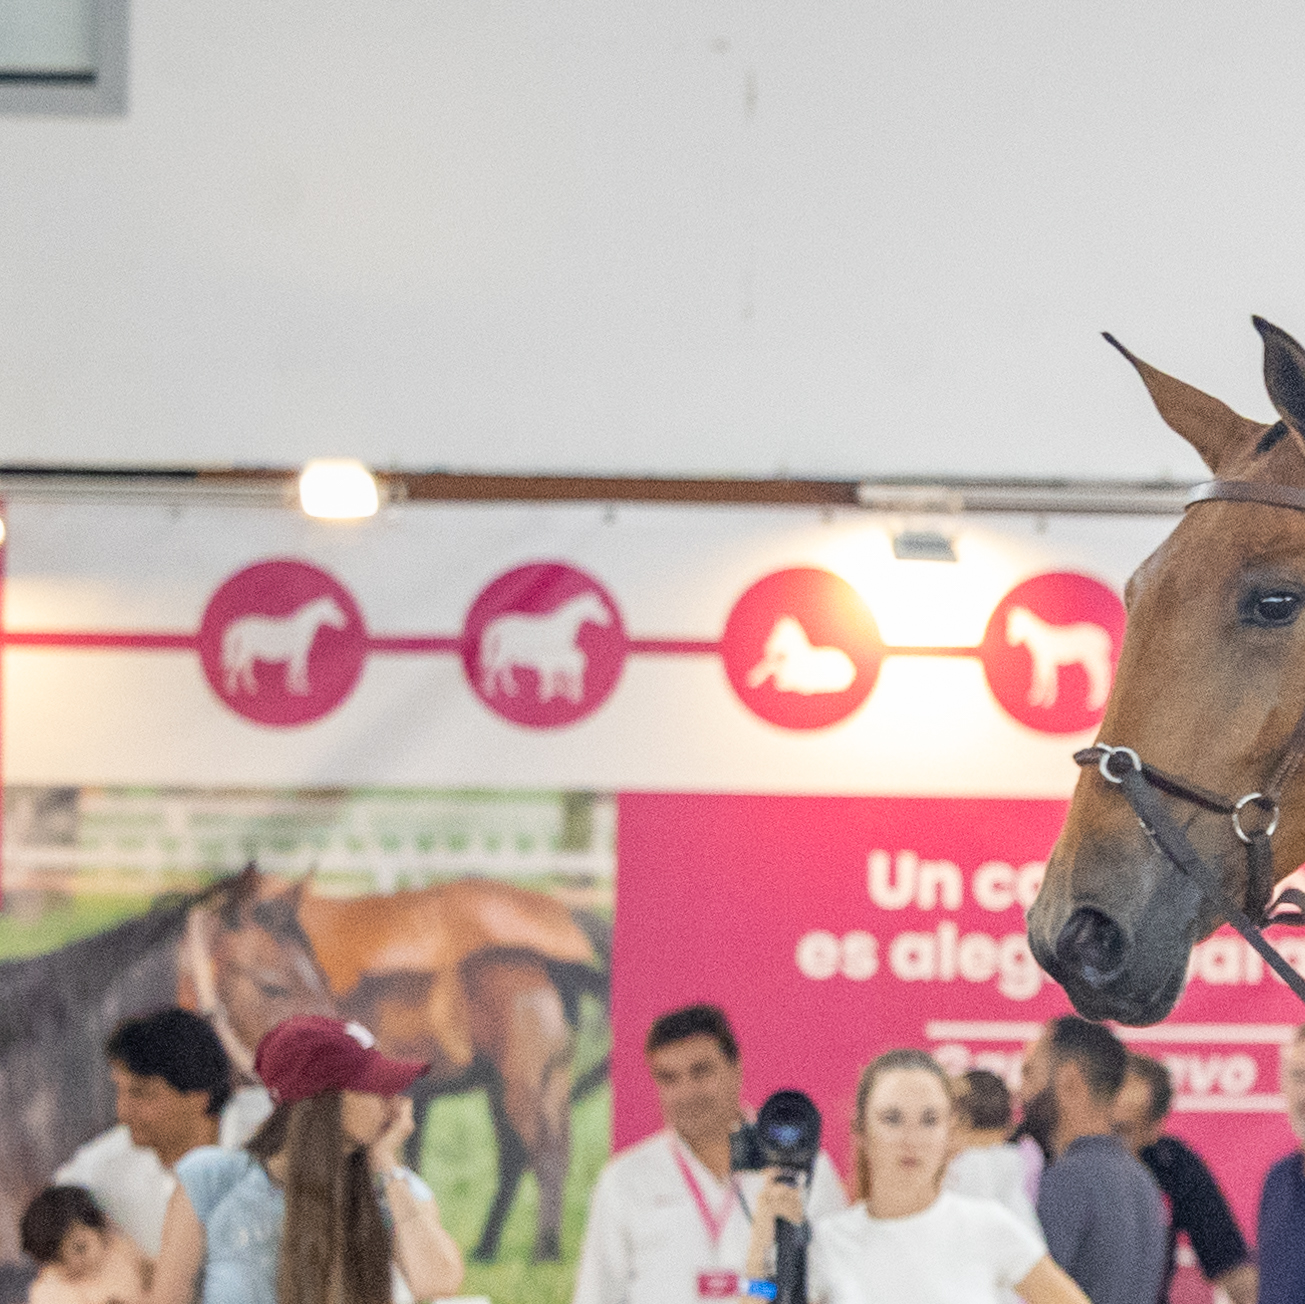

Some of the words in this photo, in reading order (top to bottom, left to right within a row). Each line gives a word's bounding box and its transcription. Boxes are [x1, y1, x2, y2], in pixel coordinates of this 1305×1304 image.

[867, 849, 963, 911] Un
[796, 931, 880, 981] es
[889, 920, 1044, 1001] aleg
